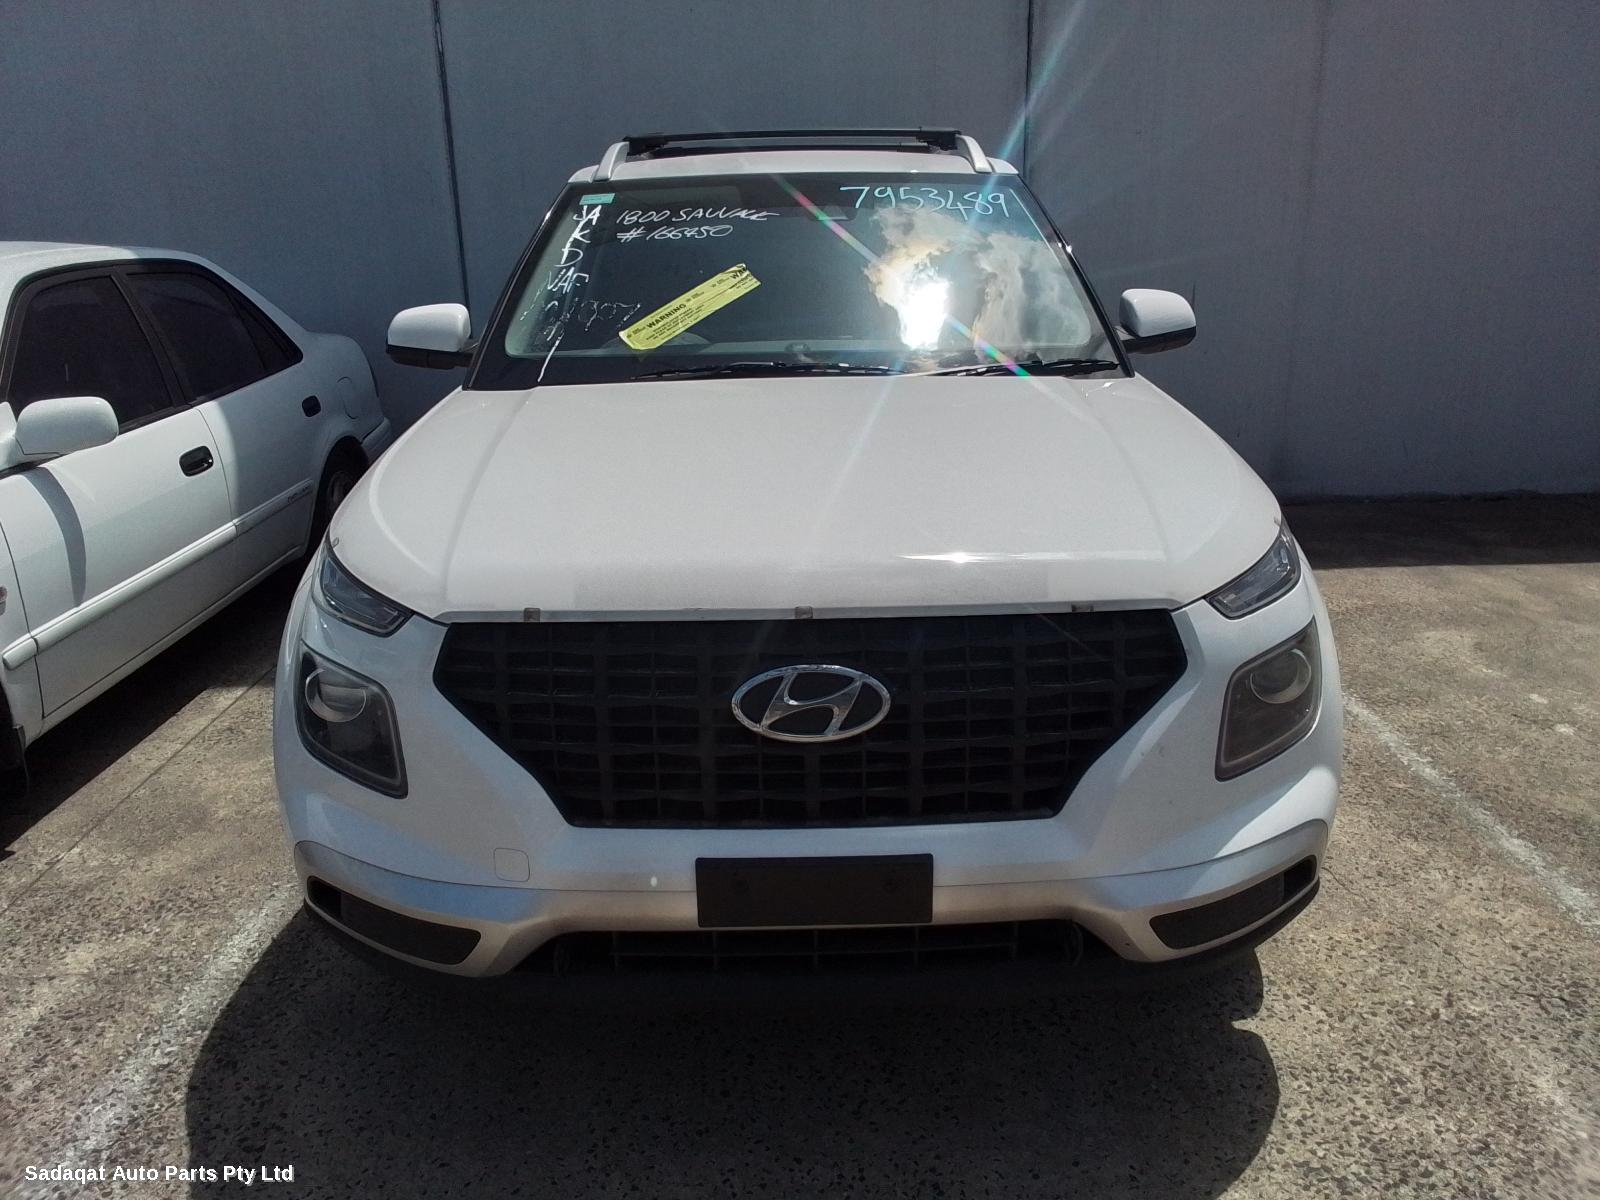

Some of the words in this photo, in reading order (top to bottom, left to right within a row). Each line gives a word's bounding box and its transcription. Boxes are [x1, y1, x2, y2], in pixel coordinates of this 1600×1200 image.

[840, 186, 1009, 221] 7953489
[616, 209, 671, 225] 1800
[646, 303, 687, 329] WARNING
